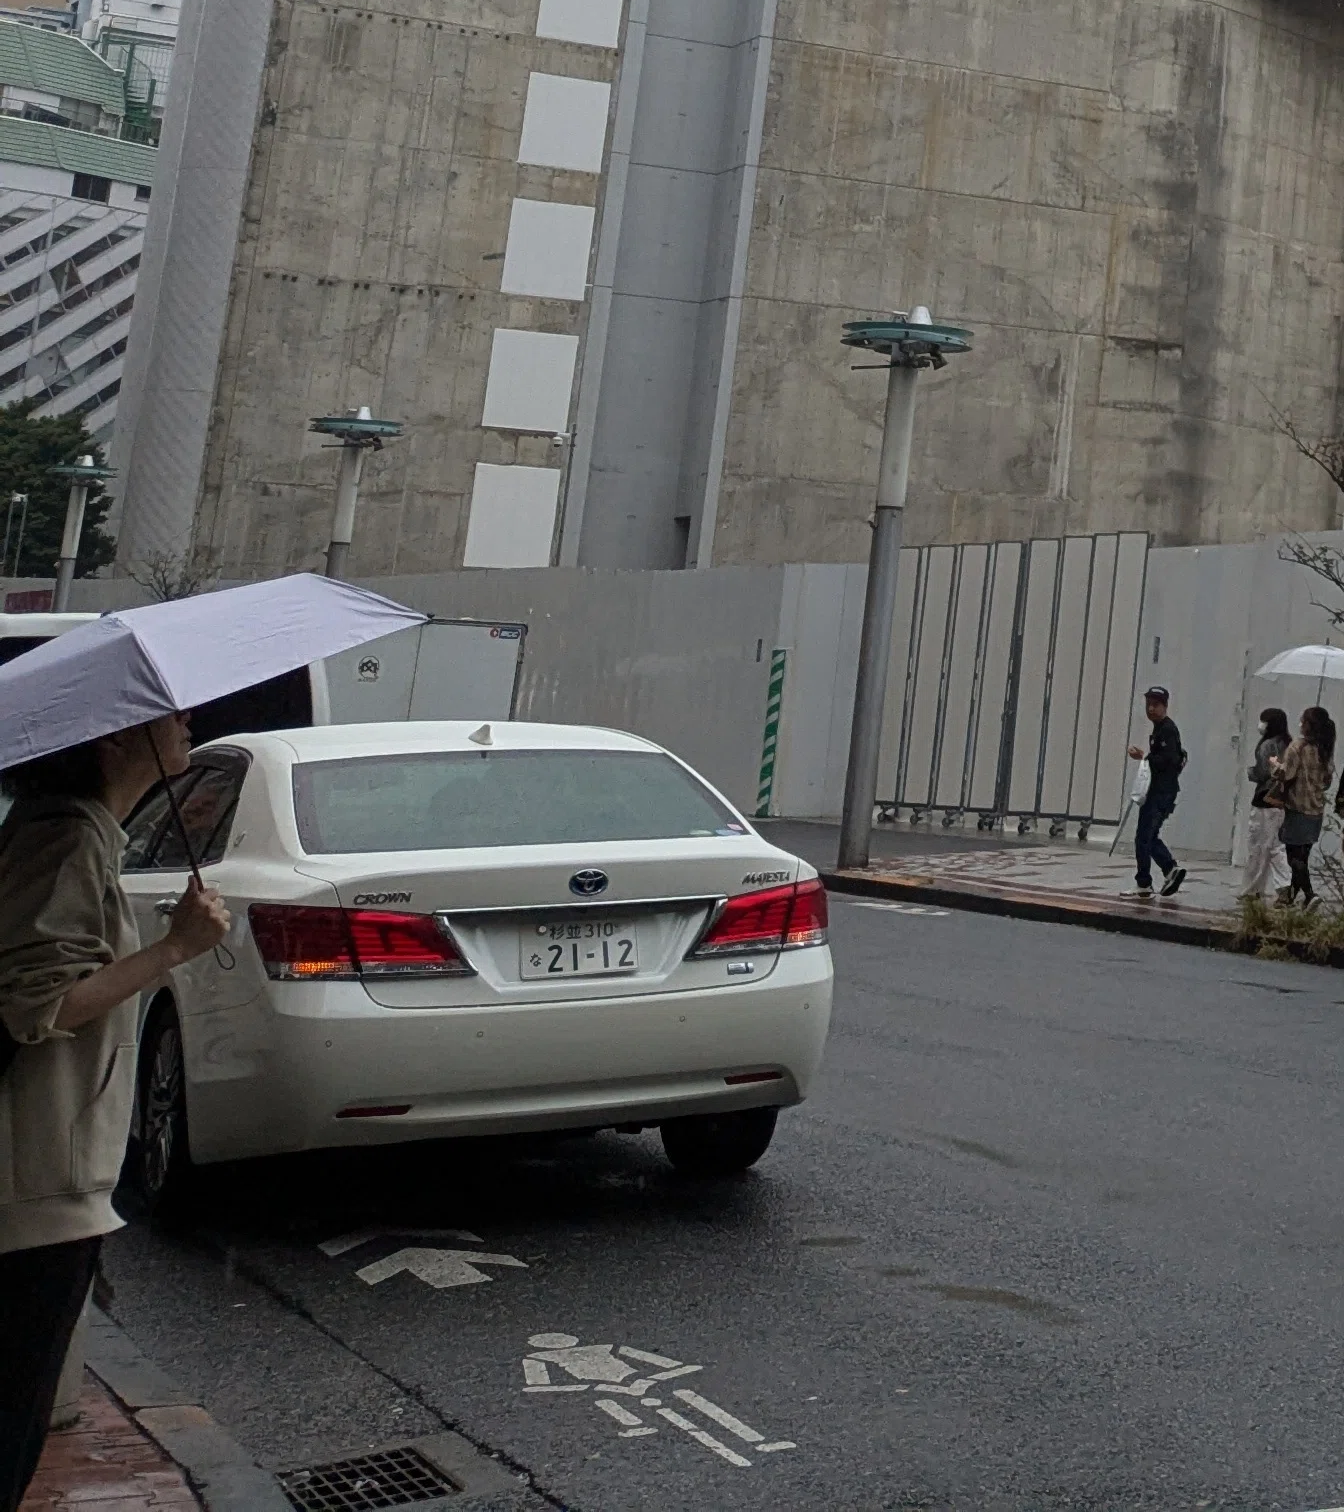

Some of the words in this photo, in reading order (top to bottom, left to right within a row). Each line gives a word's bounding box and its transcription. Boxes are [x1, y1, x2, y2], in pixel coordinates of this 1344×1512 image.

[742, 871, 791, 886] MAJESTA
[353, 891, 413, 906] CROWN
[549, 923, 582, 940] 杉並
[585, 922, 614, 938] 310
[530, 953, 542, 968] な
[547, 939, 635, 972] 21-12
